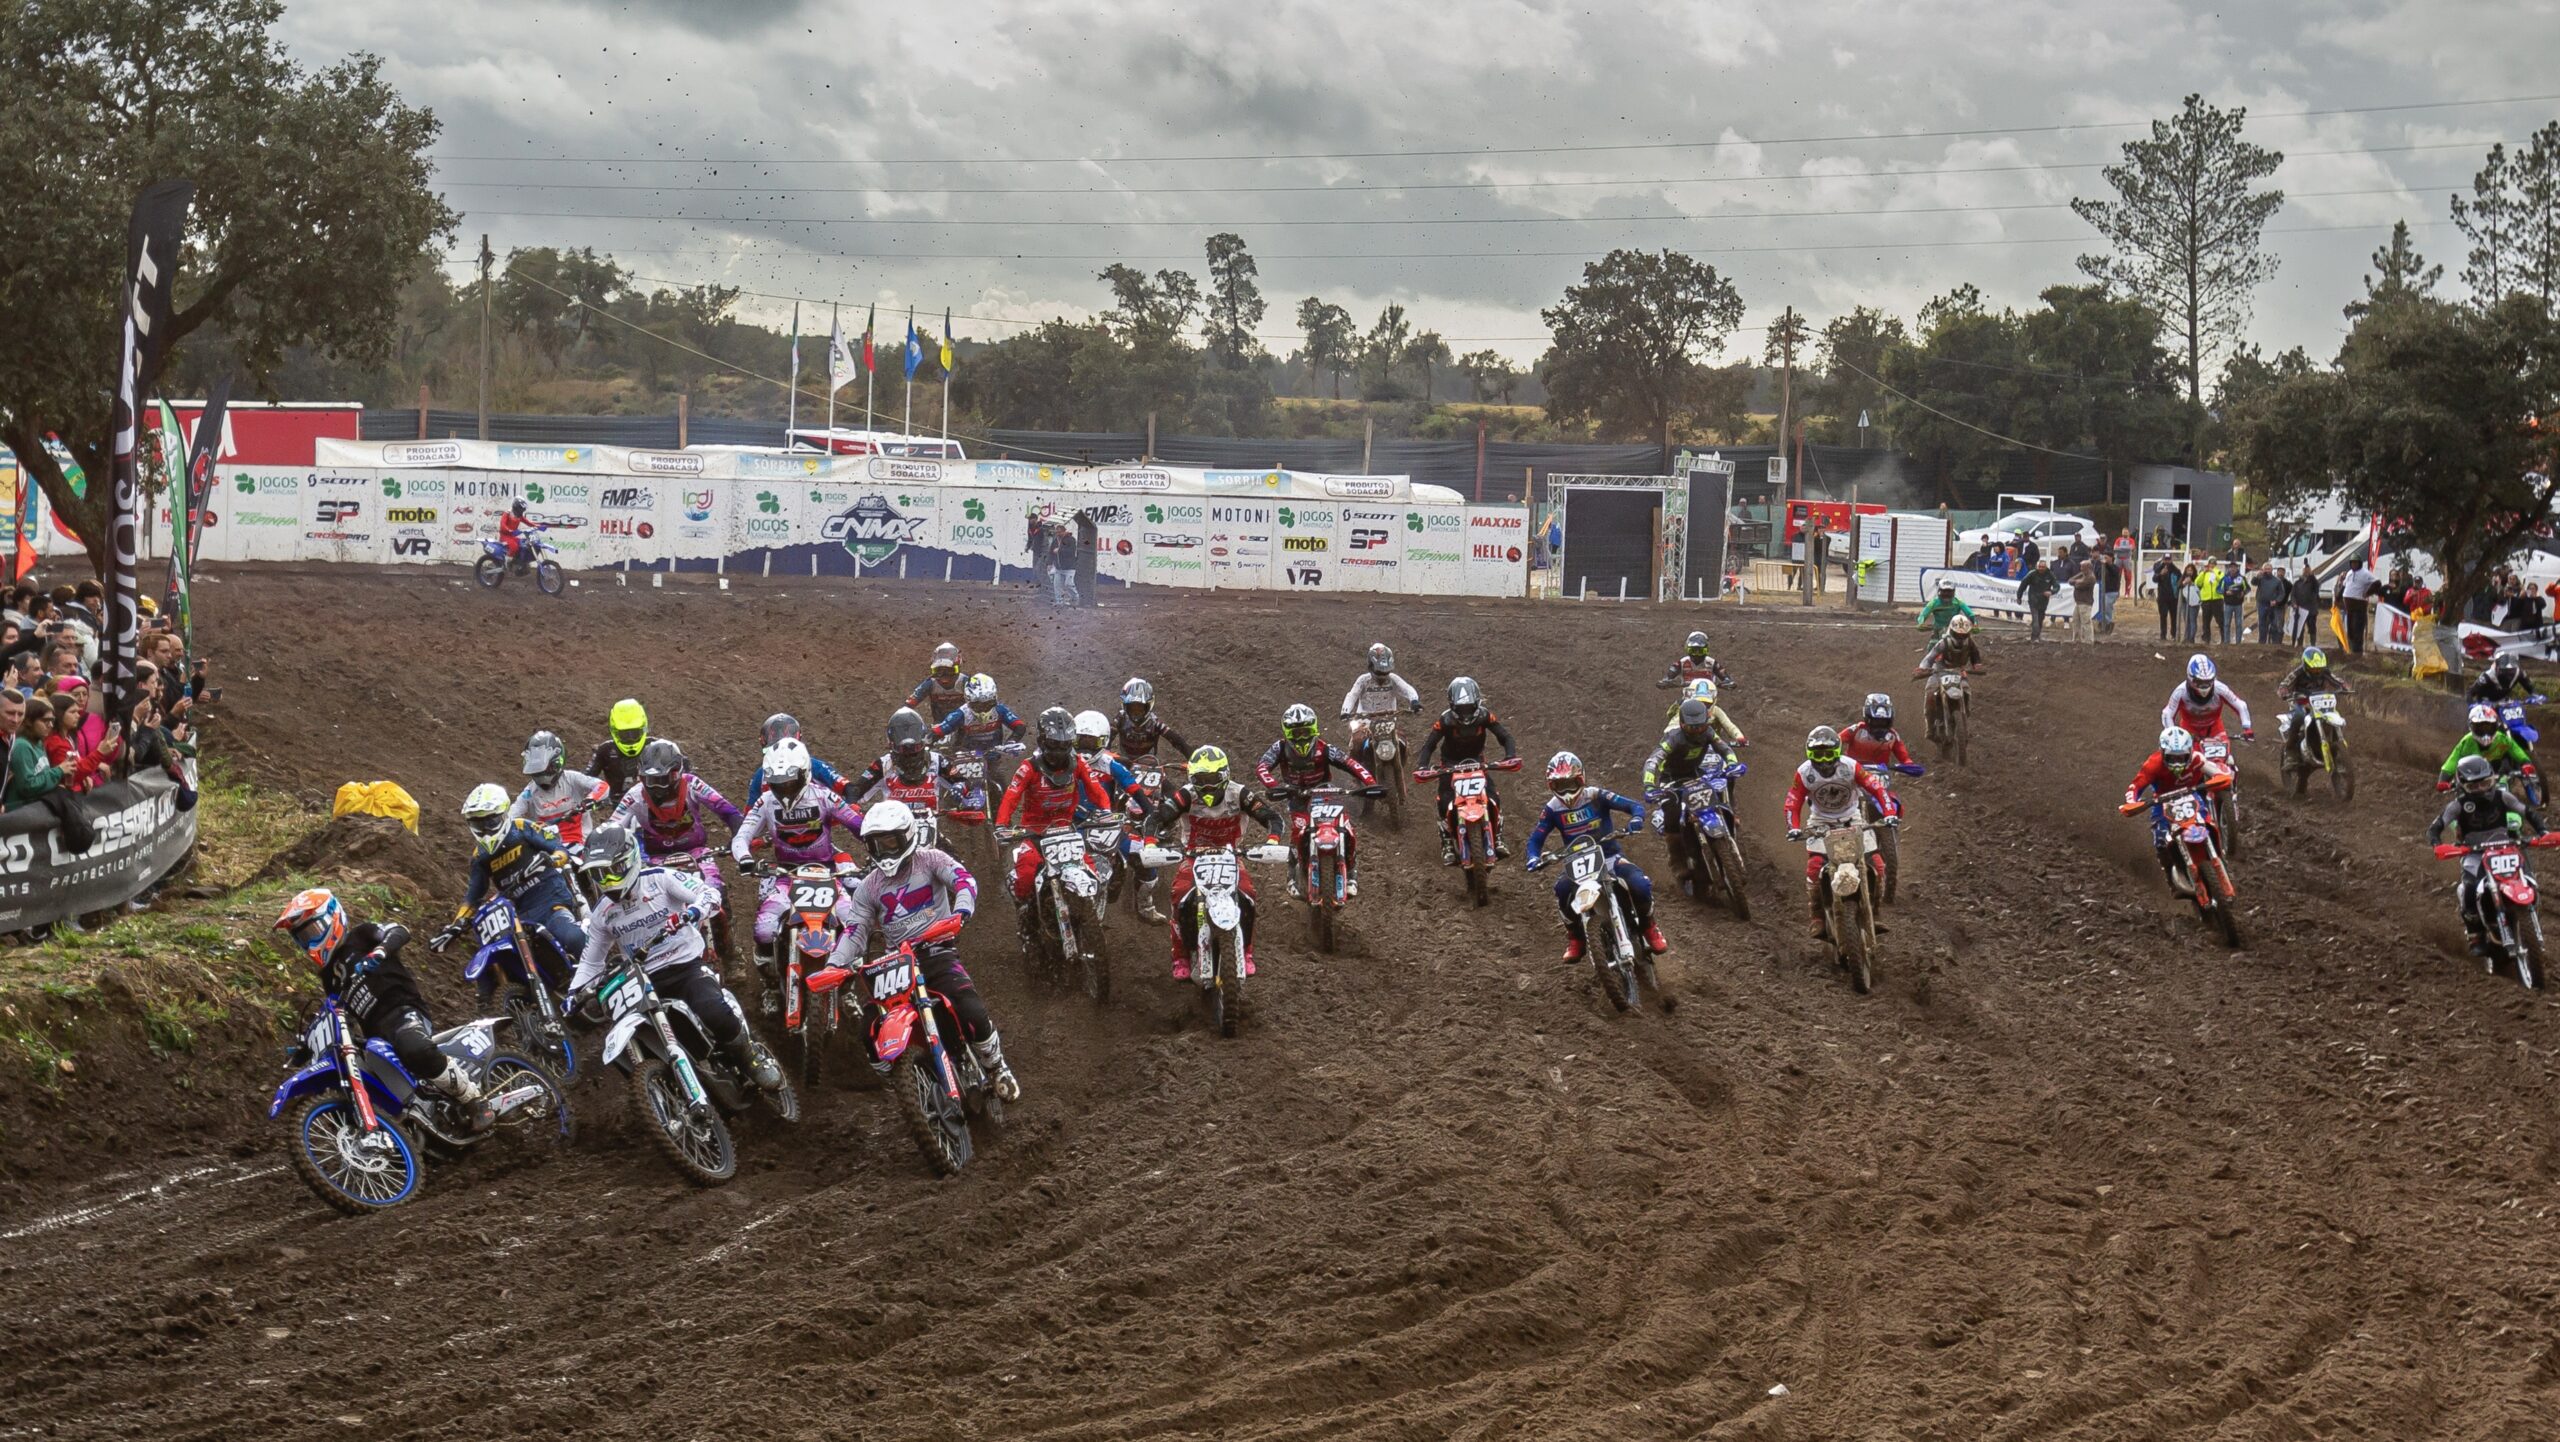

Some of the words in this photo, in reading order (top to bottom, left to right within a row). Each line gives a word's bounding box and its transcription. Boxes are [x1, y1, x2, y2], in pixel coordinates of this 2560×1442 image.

[406, 446, 456, 454] PRODUTOS
[511, 449, 561, 461] SORRIA
[407, 454, 456, 462] SODACASA
[651, 457, 699, 465] PRODUTOS
[754, 459, 799, 471] SORRIA
[651, 464, 699, 472] SODACASA
[890, 464, 937, 472] PRODUTOS
[890, 471, 937, 479] SODACASA
[990, 466, 1035, 479] SORRIA
[1120, 472, 1166, 480] PRODUTOS
[1217, 475, 1263, 486] SORRIA
[259, 476, 298, 491] JOGOS
[407, 480, 446, 494] JOGOS
[454, 481, 517, 497] MOTONI
[550, 485, 589, 498] JOGOS
[601, 488, 638, 507] FMP
[1346, 488, 1389, 496] SODACASA
[388, 508, 436, 523] moto
[1167, 506, 1203, 520] JOGOS
[1212, 507, 1270, 523] MOTONI
[1299, 511, 1333, 525] JOGOS
[1352, 513, 1399, 521] SCOTT
[600, 520, 633, 535] HELL
[747, 519, 790, 534] JOGOS
[1427, 514, 1461, 528] JOGOS
[1471, 516, 1522, 528] MAXXIS
[306, 531, 370, 541] CROSSPRO
[952, 525, 994, 540] JOGOS
[1144, 532, 1204, 546] Beta
[392, 538, 432, 556] VR
[1284, 537, 1326, 551] moto
[1472, 544, 1504, 559] HELL
[1341, 558, 1397, 567] CROSSPRO
[1286, 568, 1323, 586] VR
[1454, 779, 1485, 796] 113
[782, 807, 813, 820] KENNY
[1310, 805, 1344, 819] 247
[490, 844, 523, 873] SHOT
[2491, 854, 2520, 875] 903
[1571, 852, 1596, 880] 67
[1197, 864, 1238, 886] 315
[794, 886, 836, 909] 28
[619, 907, 670, 937] Husqvarna
[873, 964, 911, 1001] 444
[608, 976, 644, 1022] 25
[461, 1028, 492, 1056] 311
